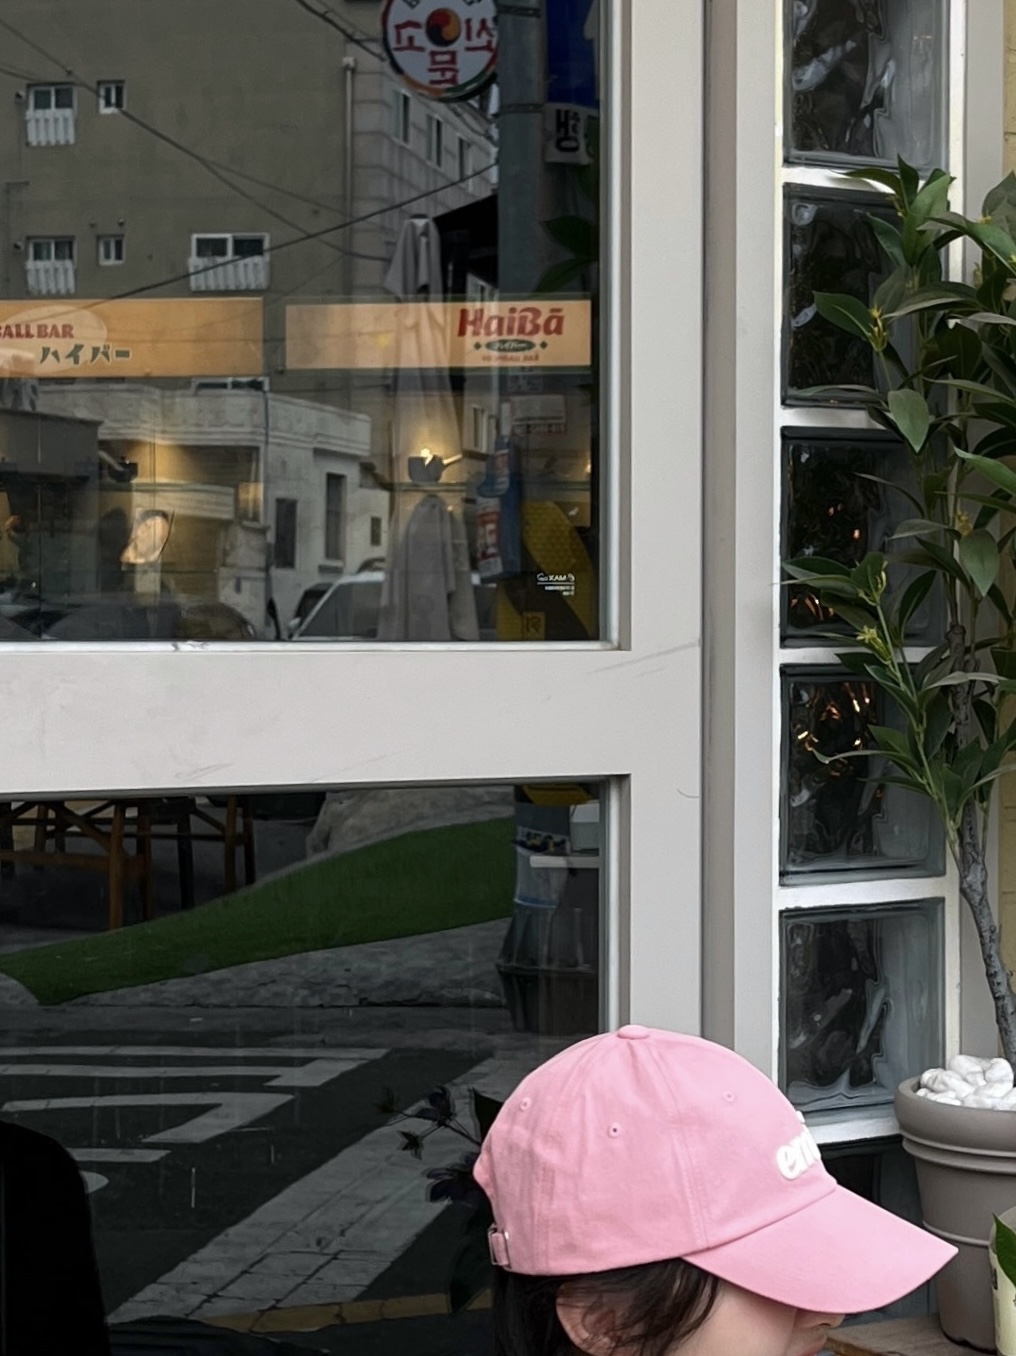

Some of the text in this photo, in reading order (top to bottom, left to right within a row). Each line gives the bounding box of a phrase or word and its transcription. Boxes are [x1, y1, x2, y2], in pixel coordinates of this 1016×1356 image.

[0, 323, 75, 339] ALL BAR
[40, 343, 131, 365] ハイバー
